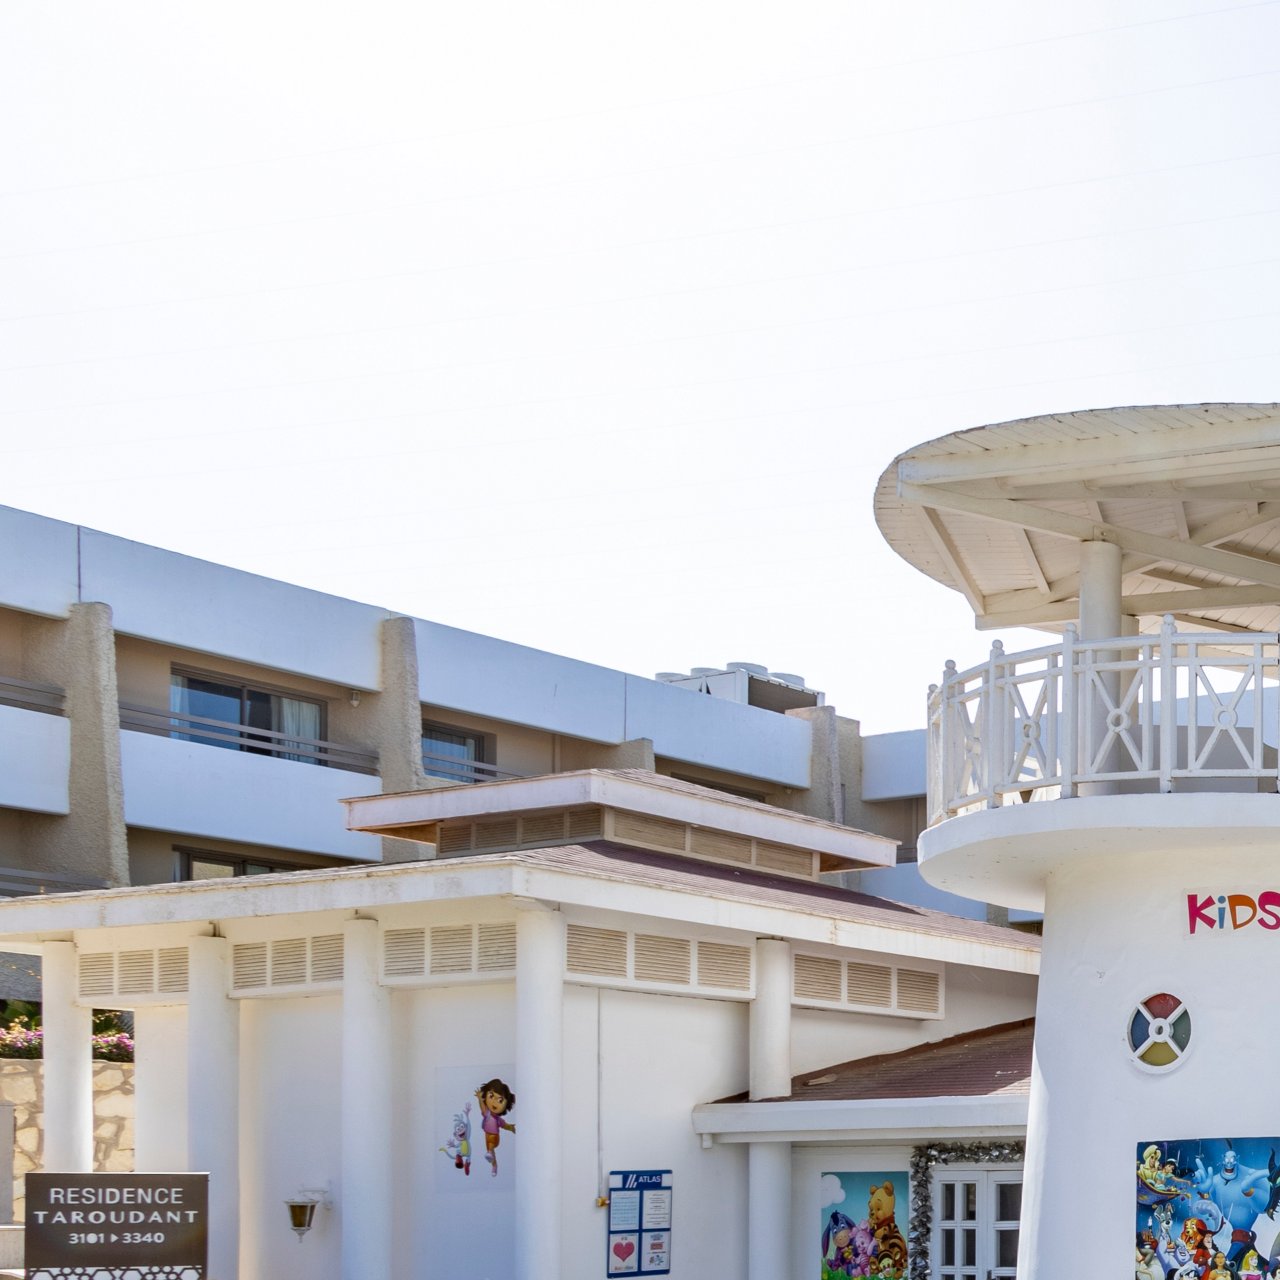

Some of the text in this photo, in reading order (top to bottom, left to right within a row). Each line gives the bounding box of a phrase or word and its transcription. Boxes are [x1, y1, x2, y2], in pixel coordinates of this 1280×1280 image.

[638, 1175, 661, 1183] ATLAS
[49, 1187, 184, 1205] RESIDENCE
[33, 1210, 199, 1224] TAROUDANT
[122, 1231, 165, 1244] 3340
